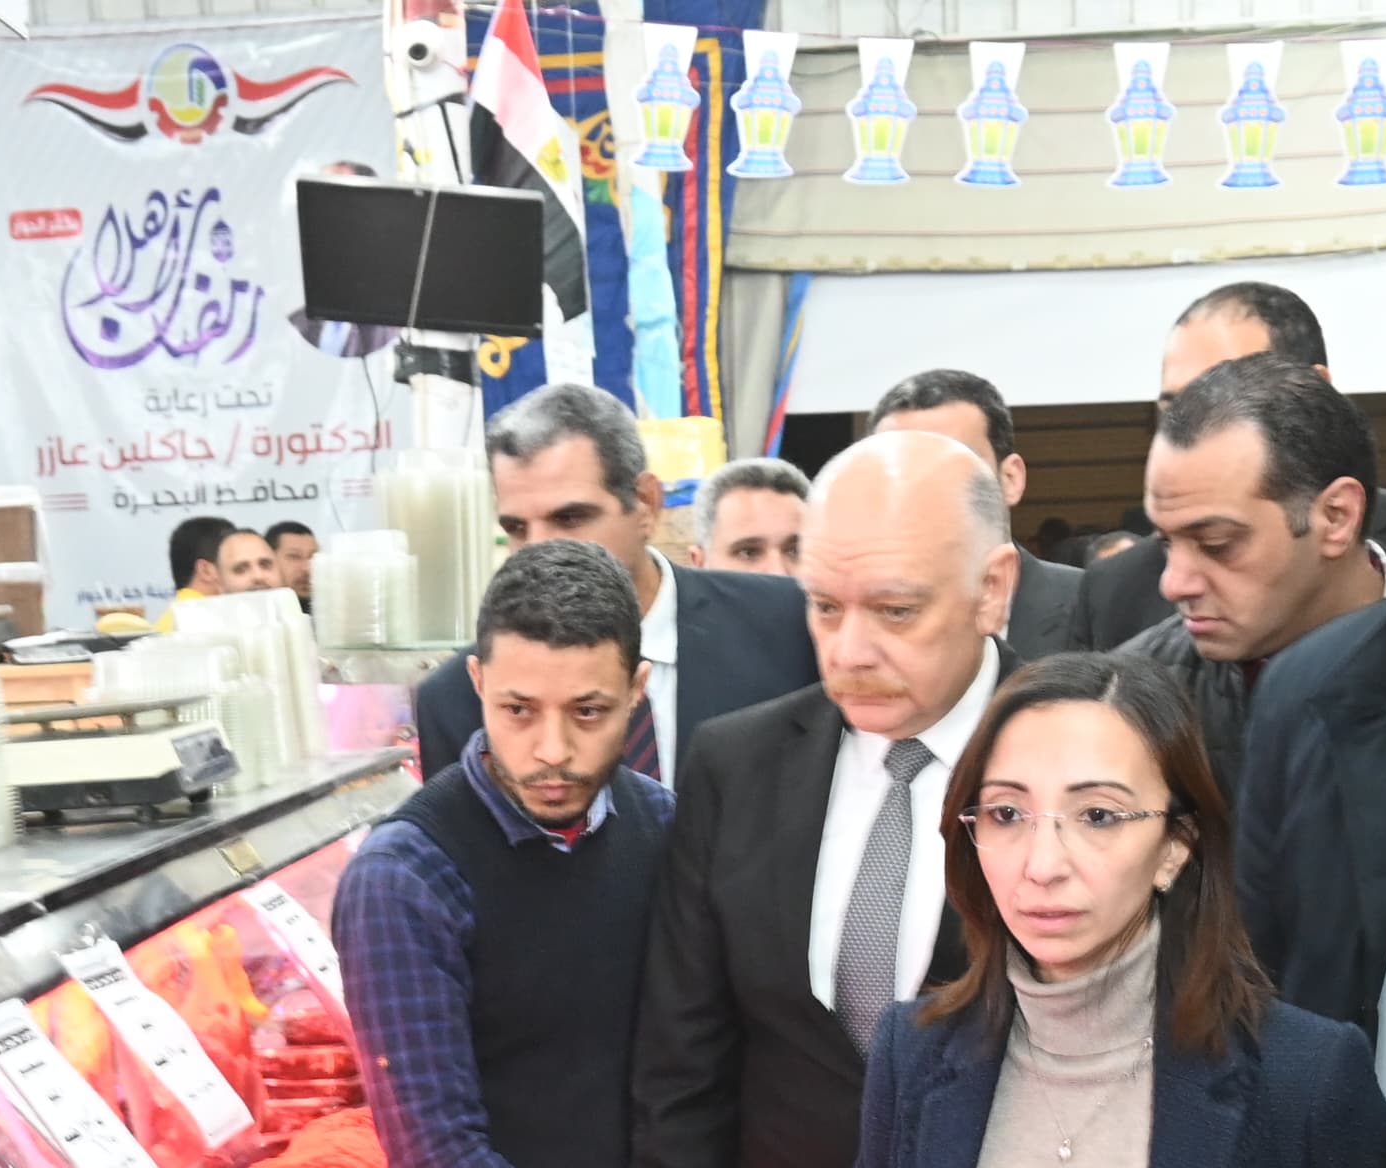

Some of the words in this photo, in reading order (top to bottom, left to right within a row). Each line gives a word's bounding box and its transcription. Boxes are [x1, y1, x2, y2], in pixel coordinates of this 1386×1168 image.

[144, 385, 208, 417] رعاية
[215, 381, 273, 409] تحت
[35, 434, 91, 478] عازر
[99, 430, 216, 472] جاكلين
[250, 418, 393, 468] الدكتورة
